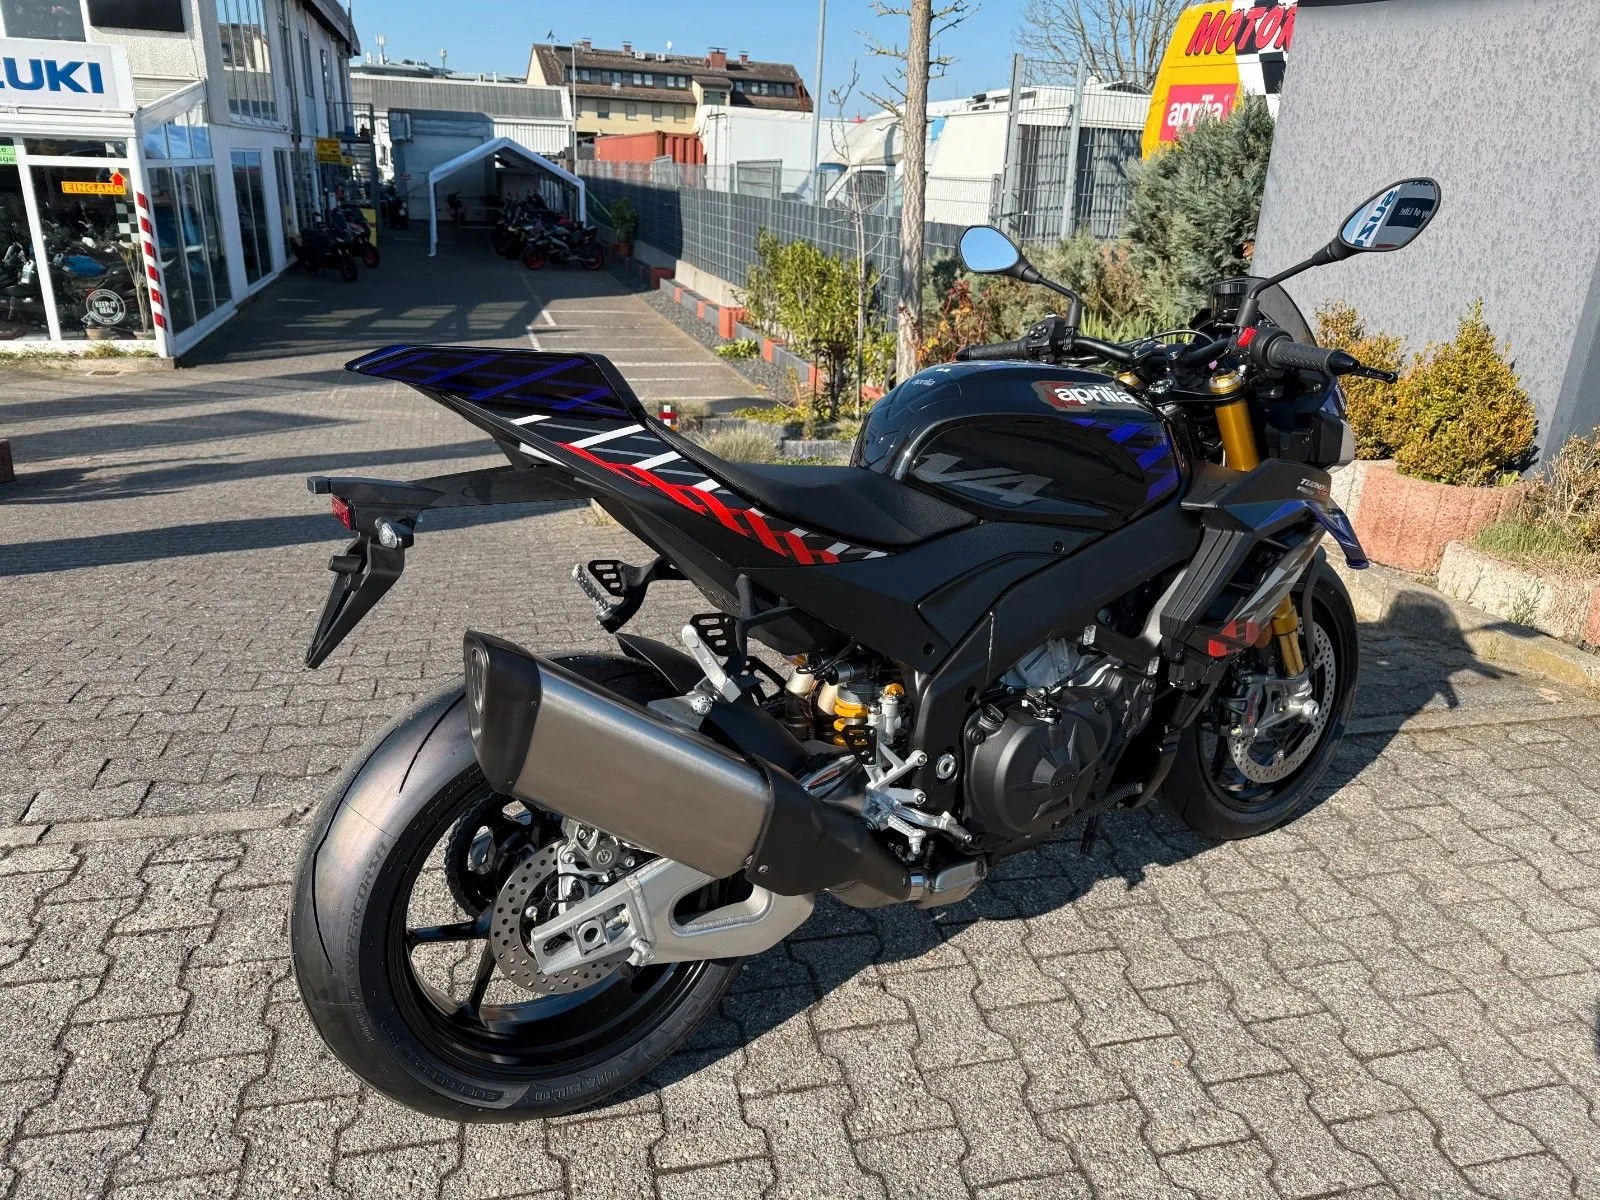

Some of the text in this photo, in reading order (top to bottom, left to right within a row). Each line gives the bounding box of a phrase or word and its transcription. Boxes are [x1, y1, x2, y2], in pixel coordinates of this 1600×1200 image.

[0, 57, 104, 94] UKI
[64, 183, 124, 193] EINGANG
[1054, 385, 1139, 405] aprilia
